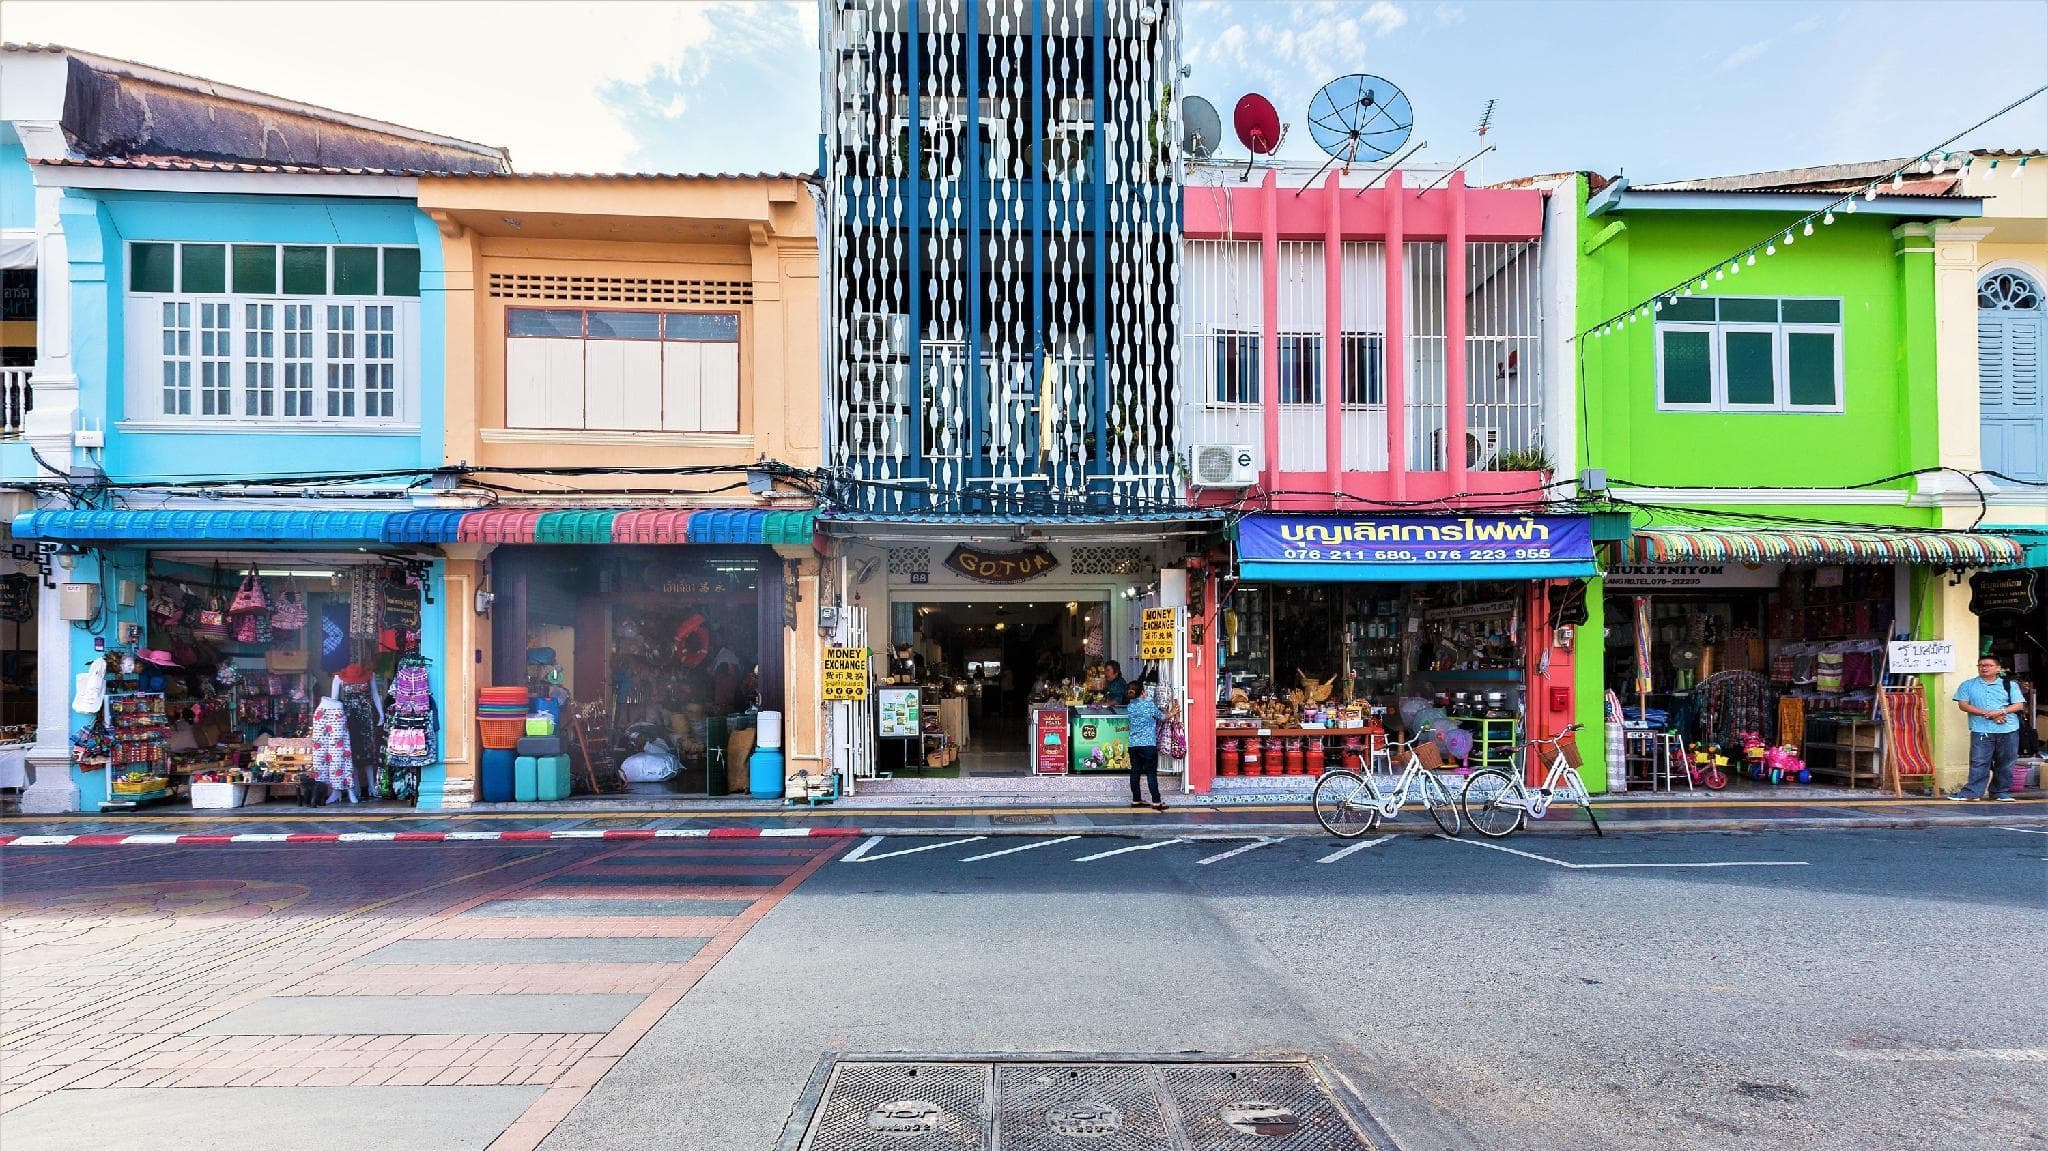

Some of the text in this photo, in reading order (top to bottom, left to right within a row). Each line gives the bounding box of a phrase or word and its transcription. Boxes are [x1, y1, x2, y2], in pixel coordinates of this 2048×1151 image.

[1281, 516, 1549, 547] บุญเลิศการไฟฟ้า
[1285, 549, 1550, 562] 076 211 680, 076 223 955
[1146, 609, 1171, 620] MONEY
[1143, 620, 1174, 630] EXCHANGE
[827, 649, 861, 659] MONEY
[824, 660, 865, 670] EXCHANGE
